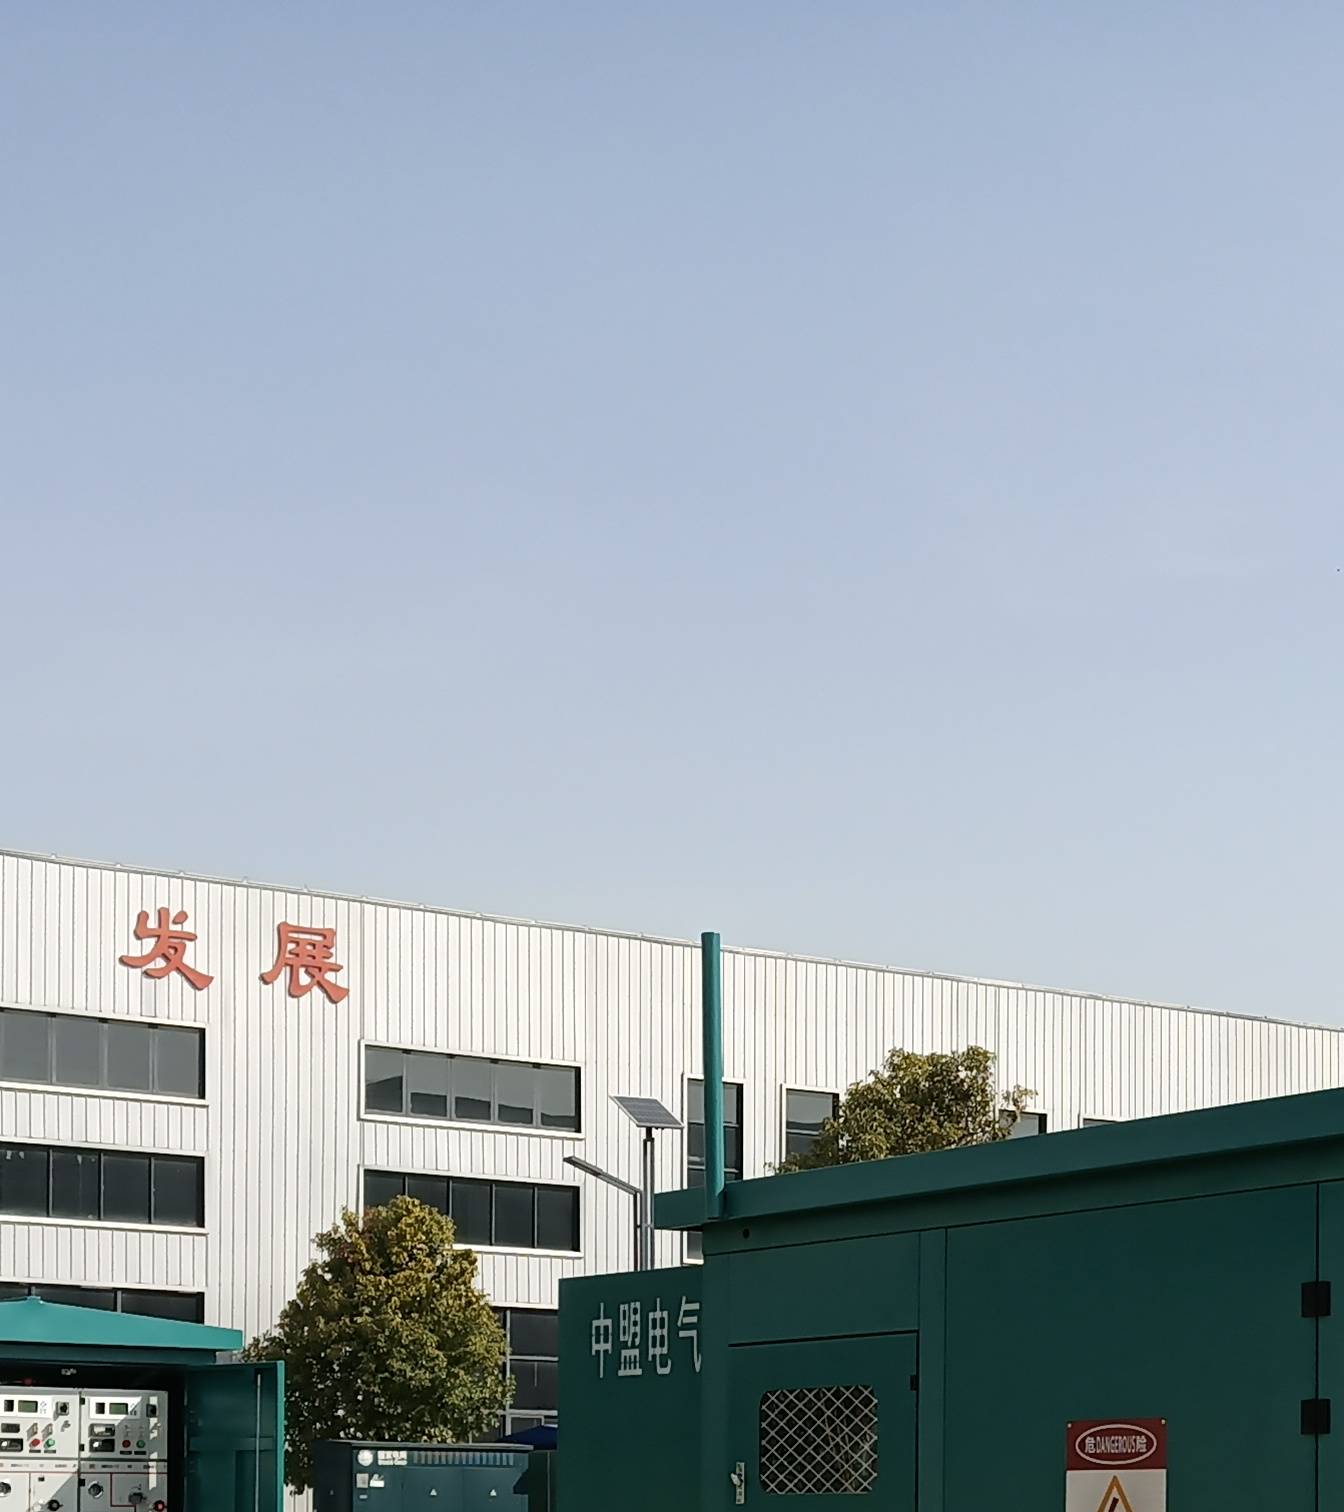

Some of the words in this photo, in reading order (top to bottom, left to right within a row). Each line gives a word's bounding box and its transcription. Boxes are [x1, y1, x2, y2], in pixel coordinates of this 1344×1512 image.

[120, 907, 350, 1003] 发展
[591, 1295, 702, 1379] 中盟电气
